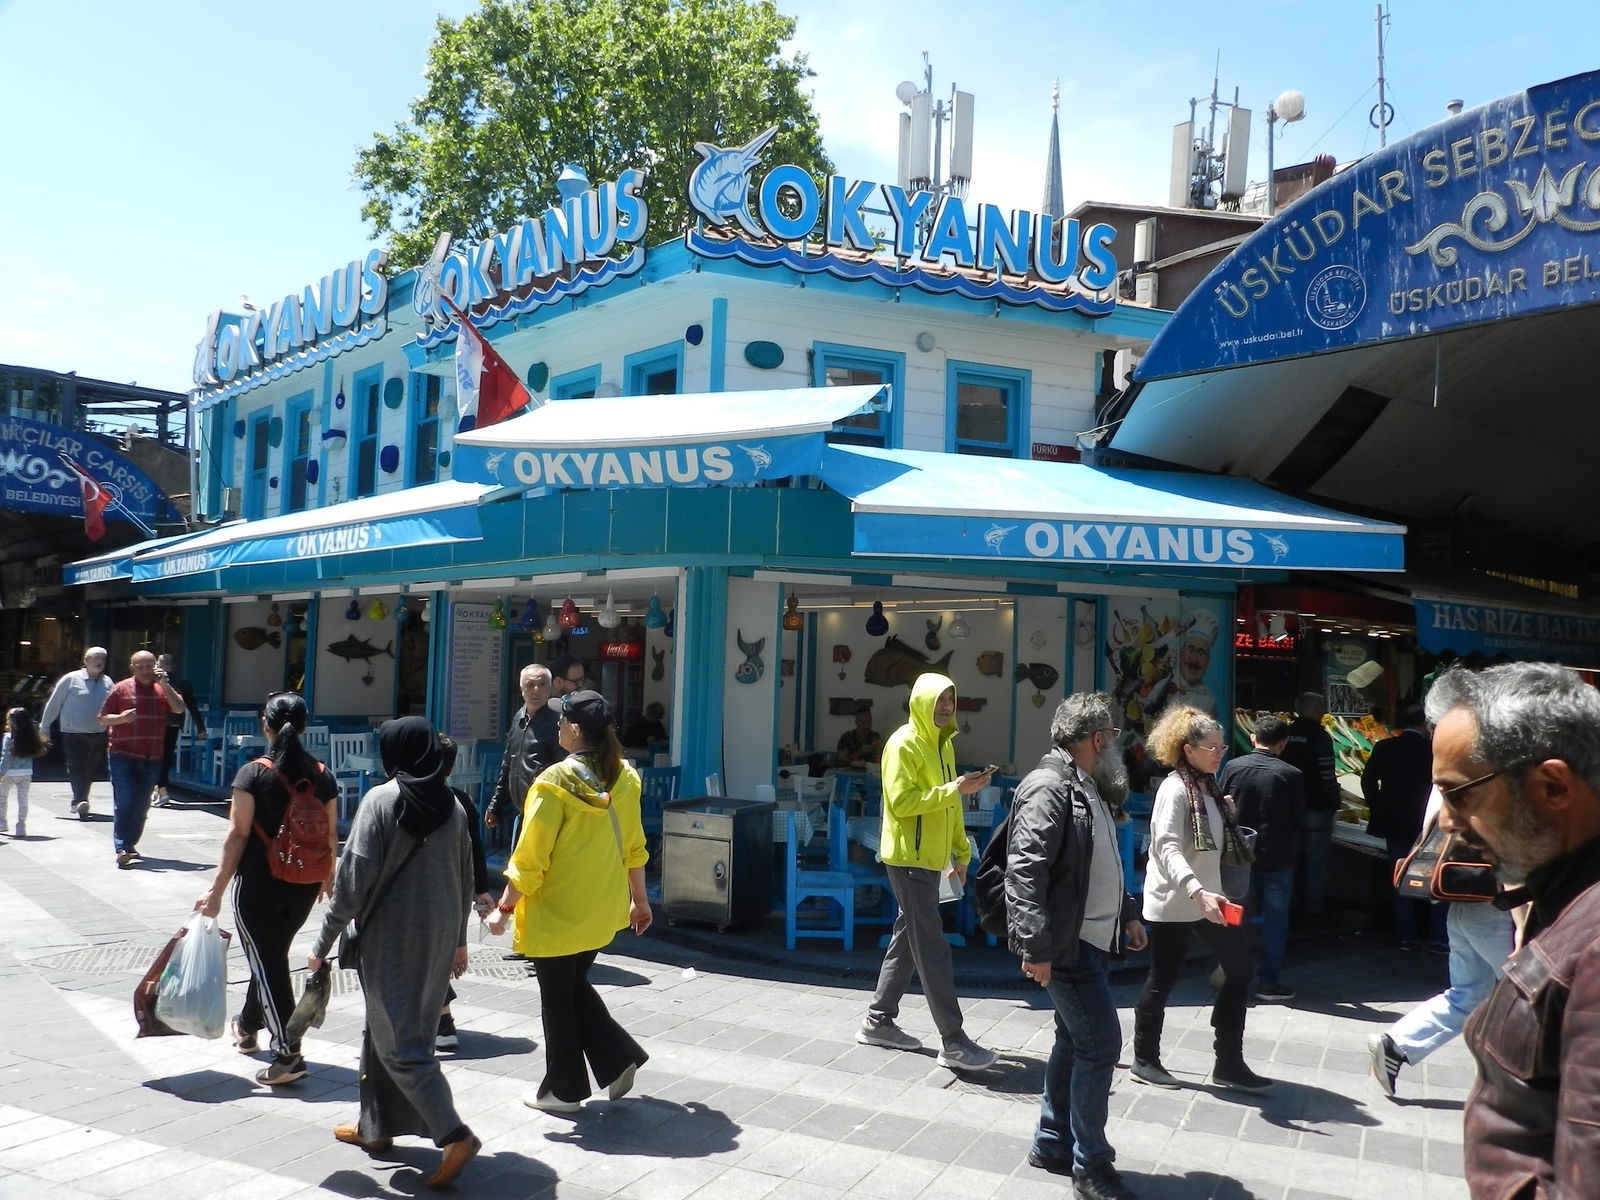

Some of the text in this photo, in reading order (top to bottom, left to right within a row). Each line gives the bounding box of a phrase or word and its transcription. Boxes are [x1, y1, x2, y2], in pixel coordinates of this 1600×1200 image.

[437, 169, 648, 316] OKYANUS
[758, 164, 1118, 291] OKYANUS
[1214, 170, 1411, 318] ÜSKÜDAR
[216, 248, 389, 383] OKYANUS
[87, 450, 153, 504] ÇARŞISI
[513, 446, 734, 486] OKYANUS
[6, 489, 80, 507] BELEDİYESİ
[297, 522, 370, 556] OKYANUS
[1024, 522, 1254, 563] OKYANUS
[163, 551, 207, 576] OKYANUS
[571, 627, 589, 635] KASA
[1432, 604, 1479, 632] HAS
[1482, 607, 1530, 637] RİZE
